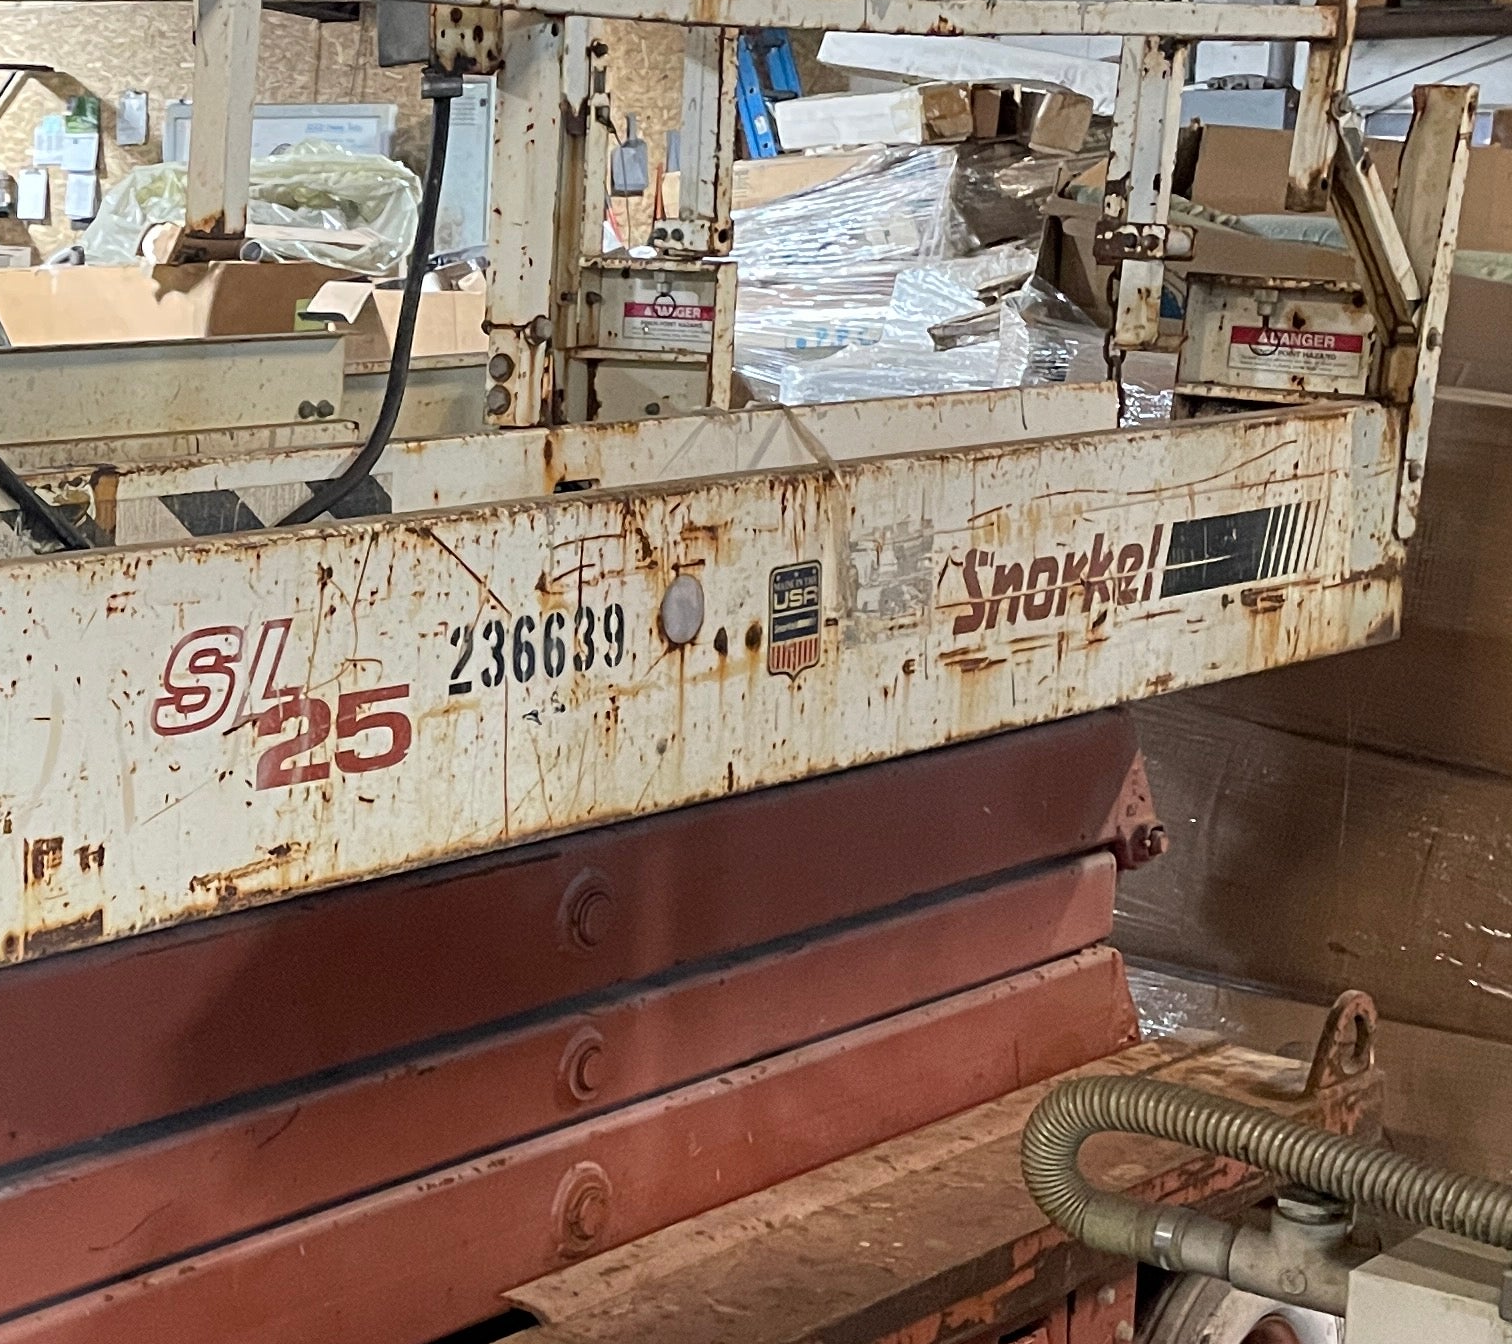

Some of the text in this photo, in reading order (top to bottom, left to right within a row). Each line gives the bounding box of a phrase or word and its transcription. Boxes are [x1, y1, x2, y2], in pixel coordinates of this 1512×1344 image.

[774, 586, 818, 610] USA
[952, 523, 1164, 636] Snorkel
[151, 618, 305, 736] SL
[448, 603, 625, 696] 236639
[256, 684, 412, 791] 25
